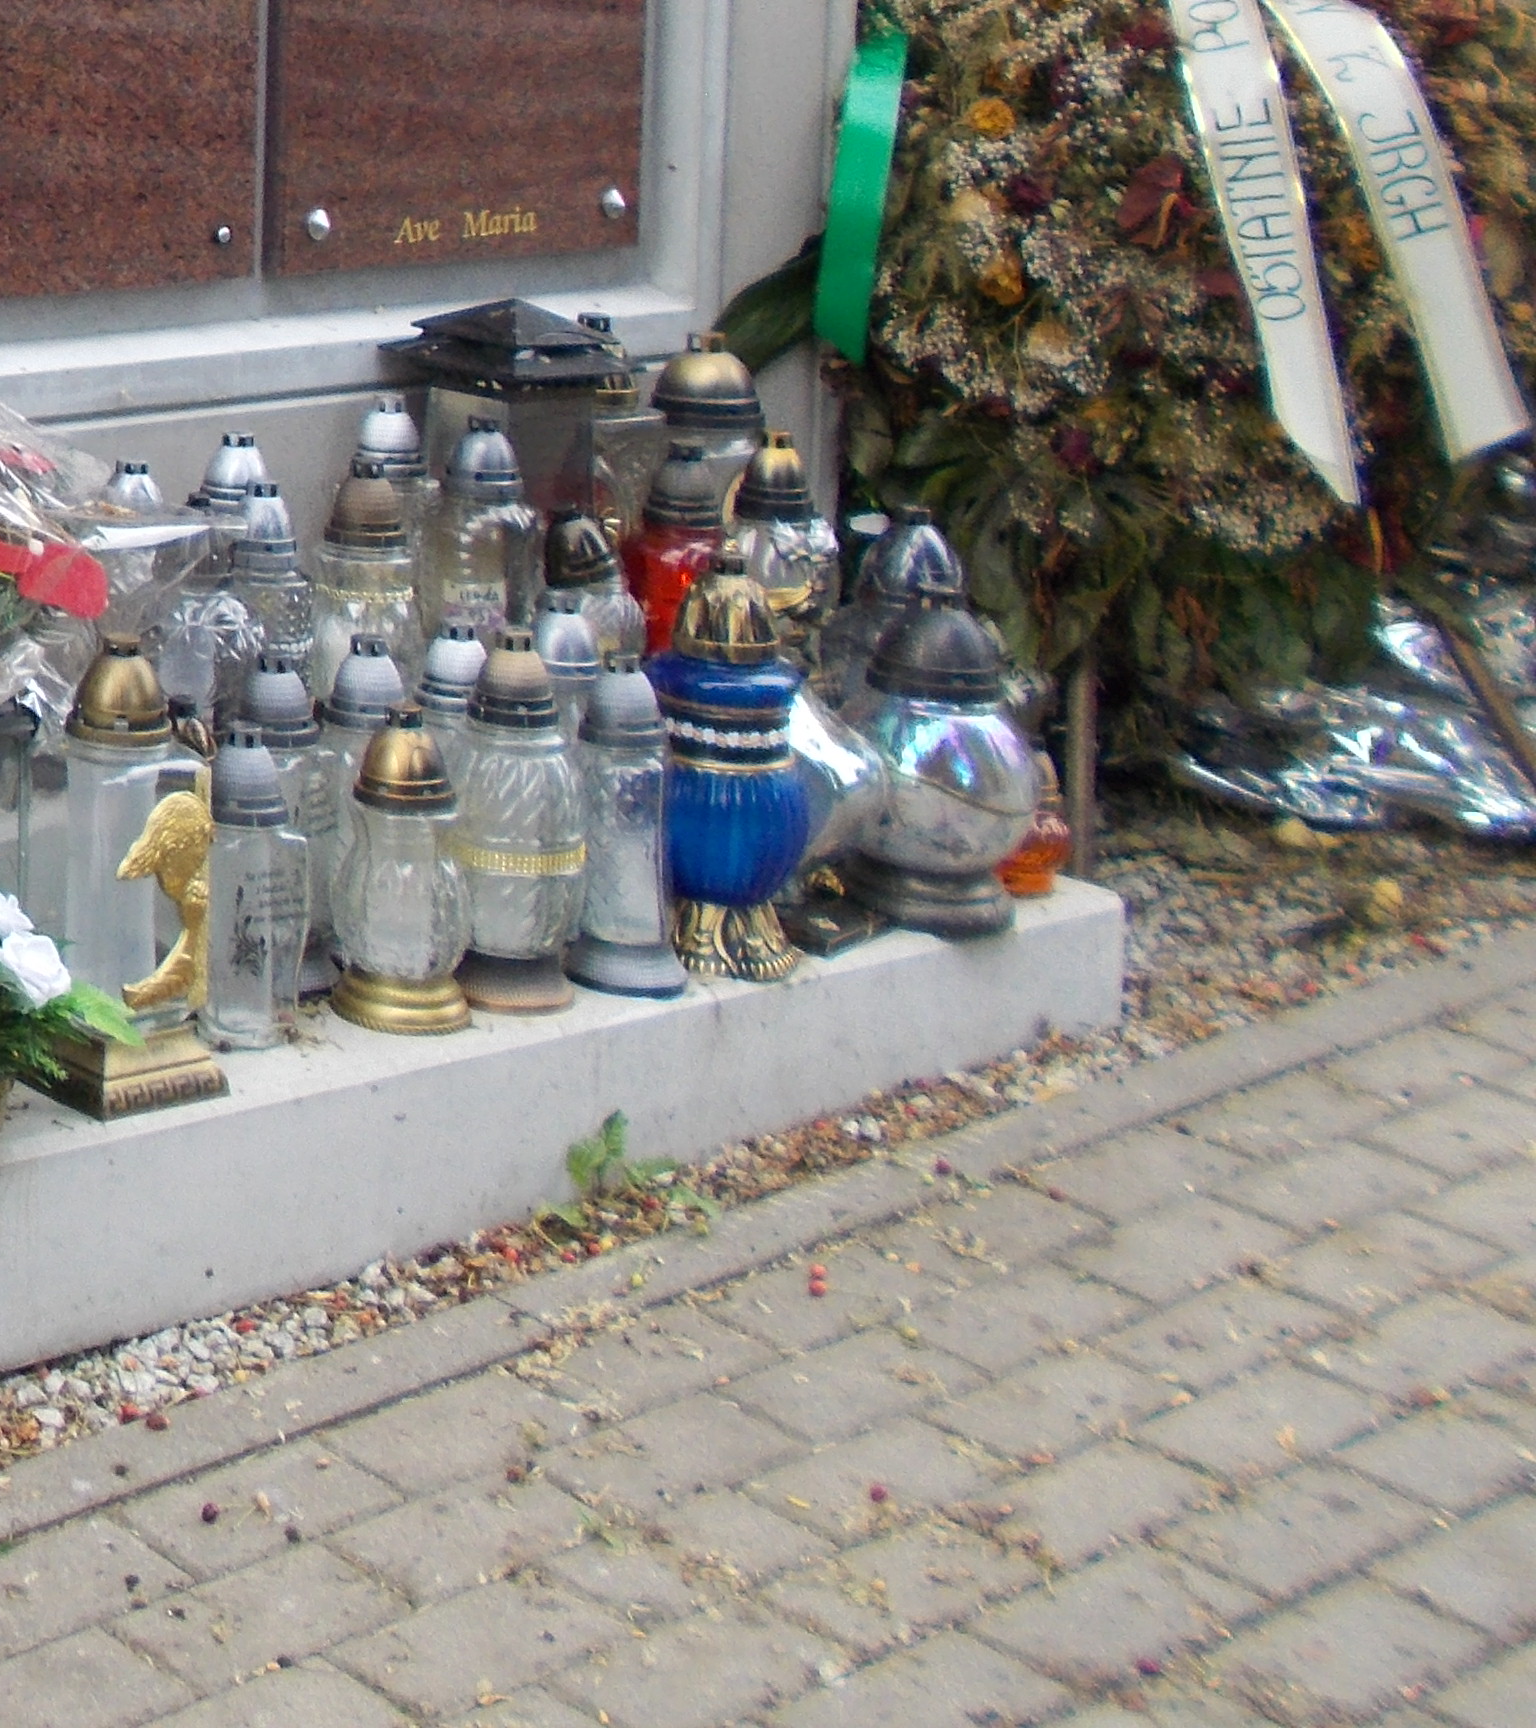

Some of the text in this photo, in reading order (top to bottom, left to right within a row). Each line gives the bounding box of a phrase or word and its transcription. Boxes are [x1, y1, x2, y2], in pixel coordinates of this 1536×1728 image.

[395, 208, 537, 244] Ave Maria
[1214, 98, 1306, 323] OSTATNIE
